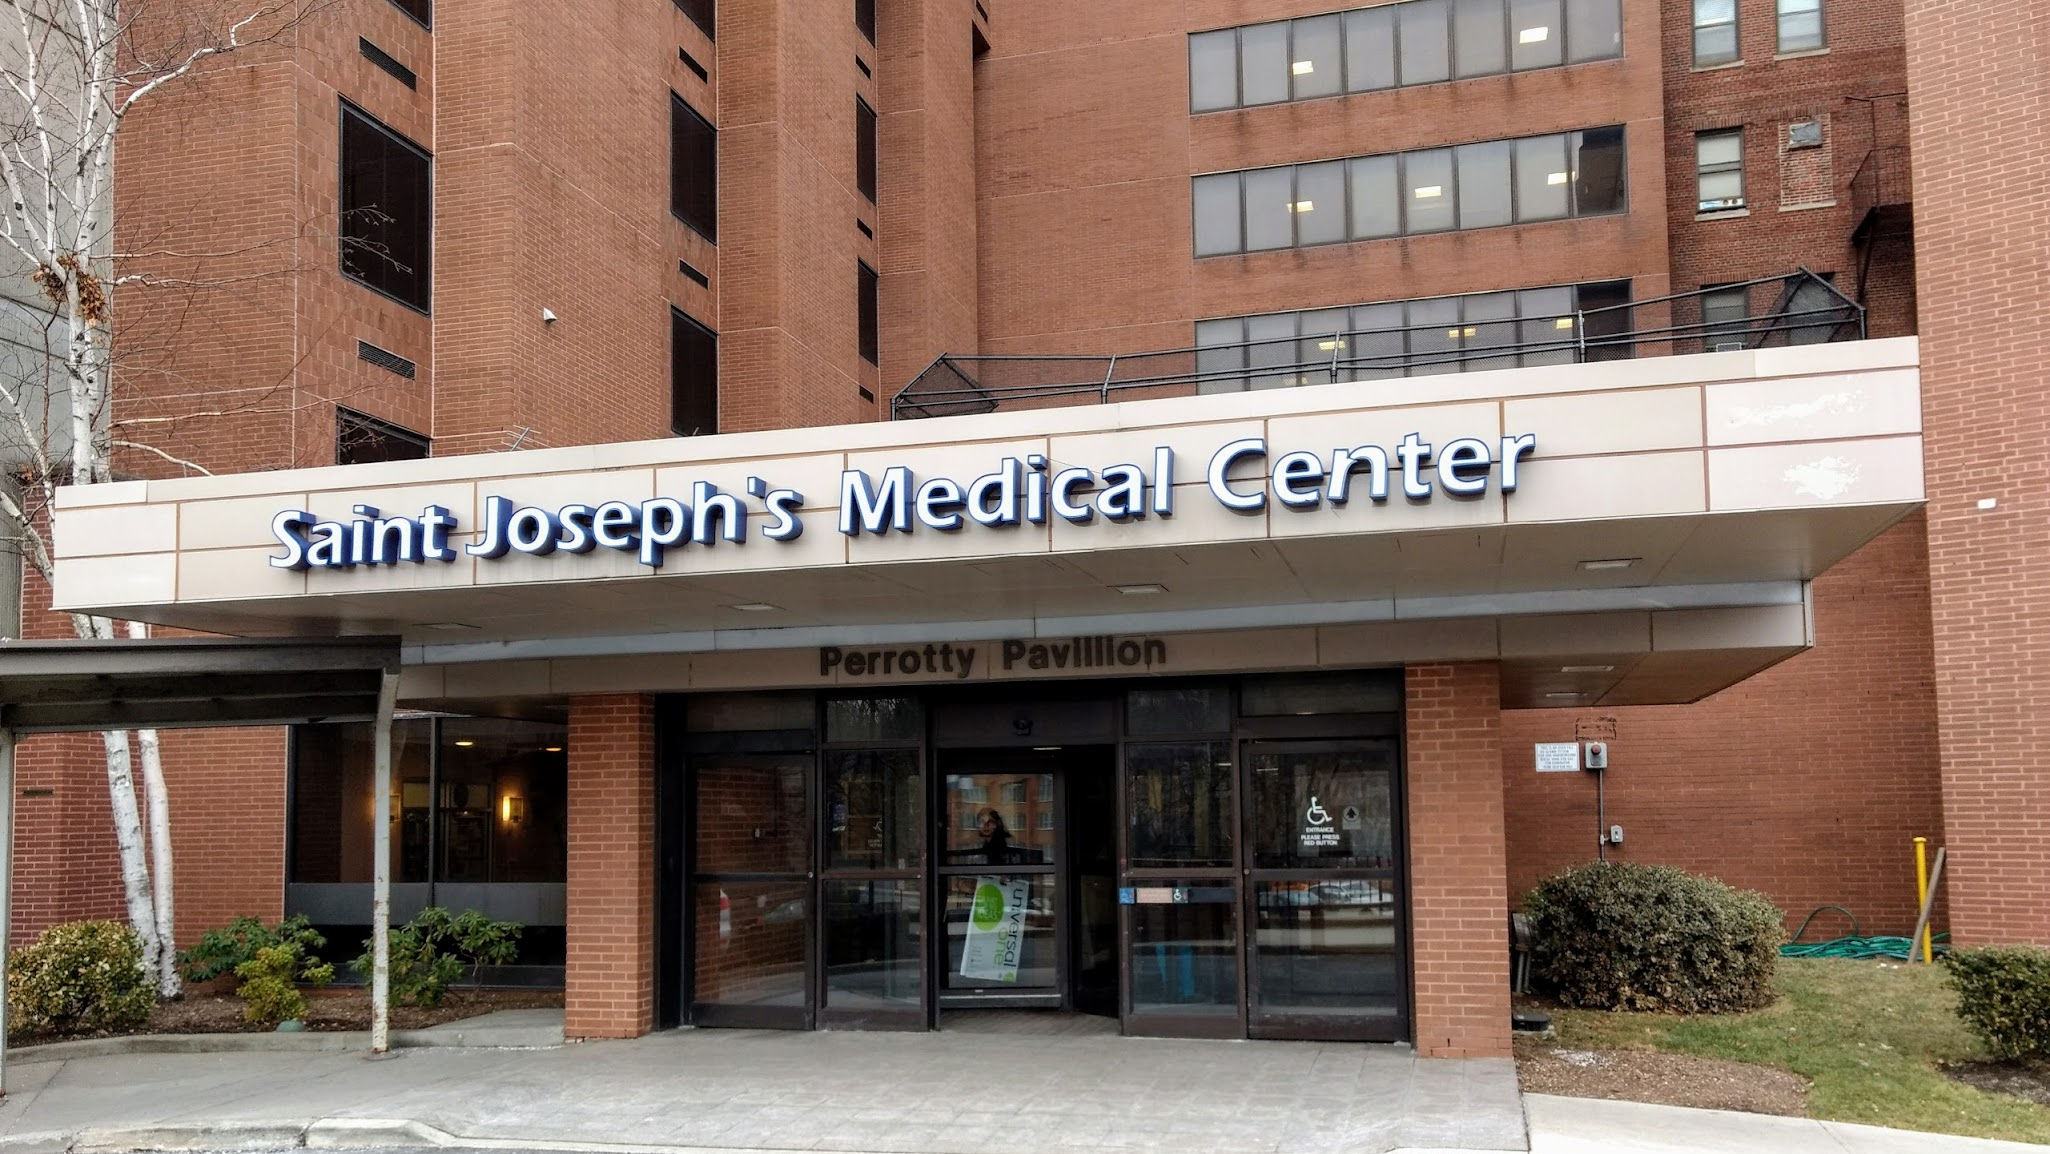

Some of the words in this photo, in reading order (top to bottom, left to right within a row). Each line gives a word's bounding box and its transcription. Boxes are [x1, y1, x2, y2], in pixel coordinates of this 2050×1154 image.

[269, 503, 457, 571] Saint
[466, 475, 804, 567] Joseph's
[838, 445, 1175, 536] Medical
[1207, 431, 1536, 509] Center
[819, 643, 976, 679] Perrotty
[1002, 635, 1166, 671] Pavillion
[994, 927, 1009, 966] one
[1003, 888, 1023, 967] universal
